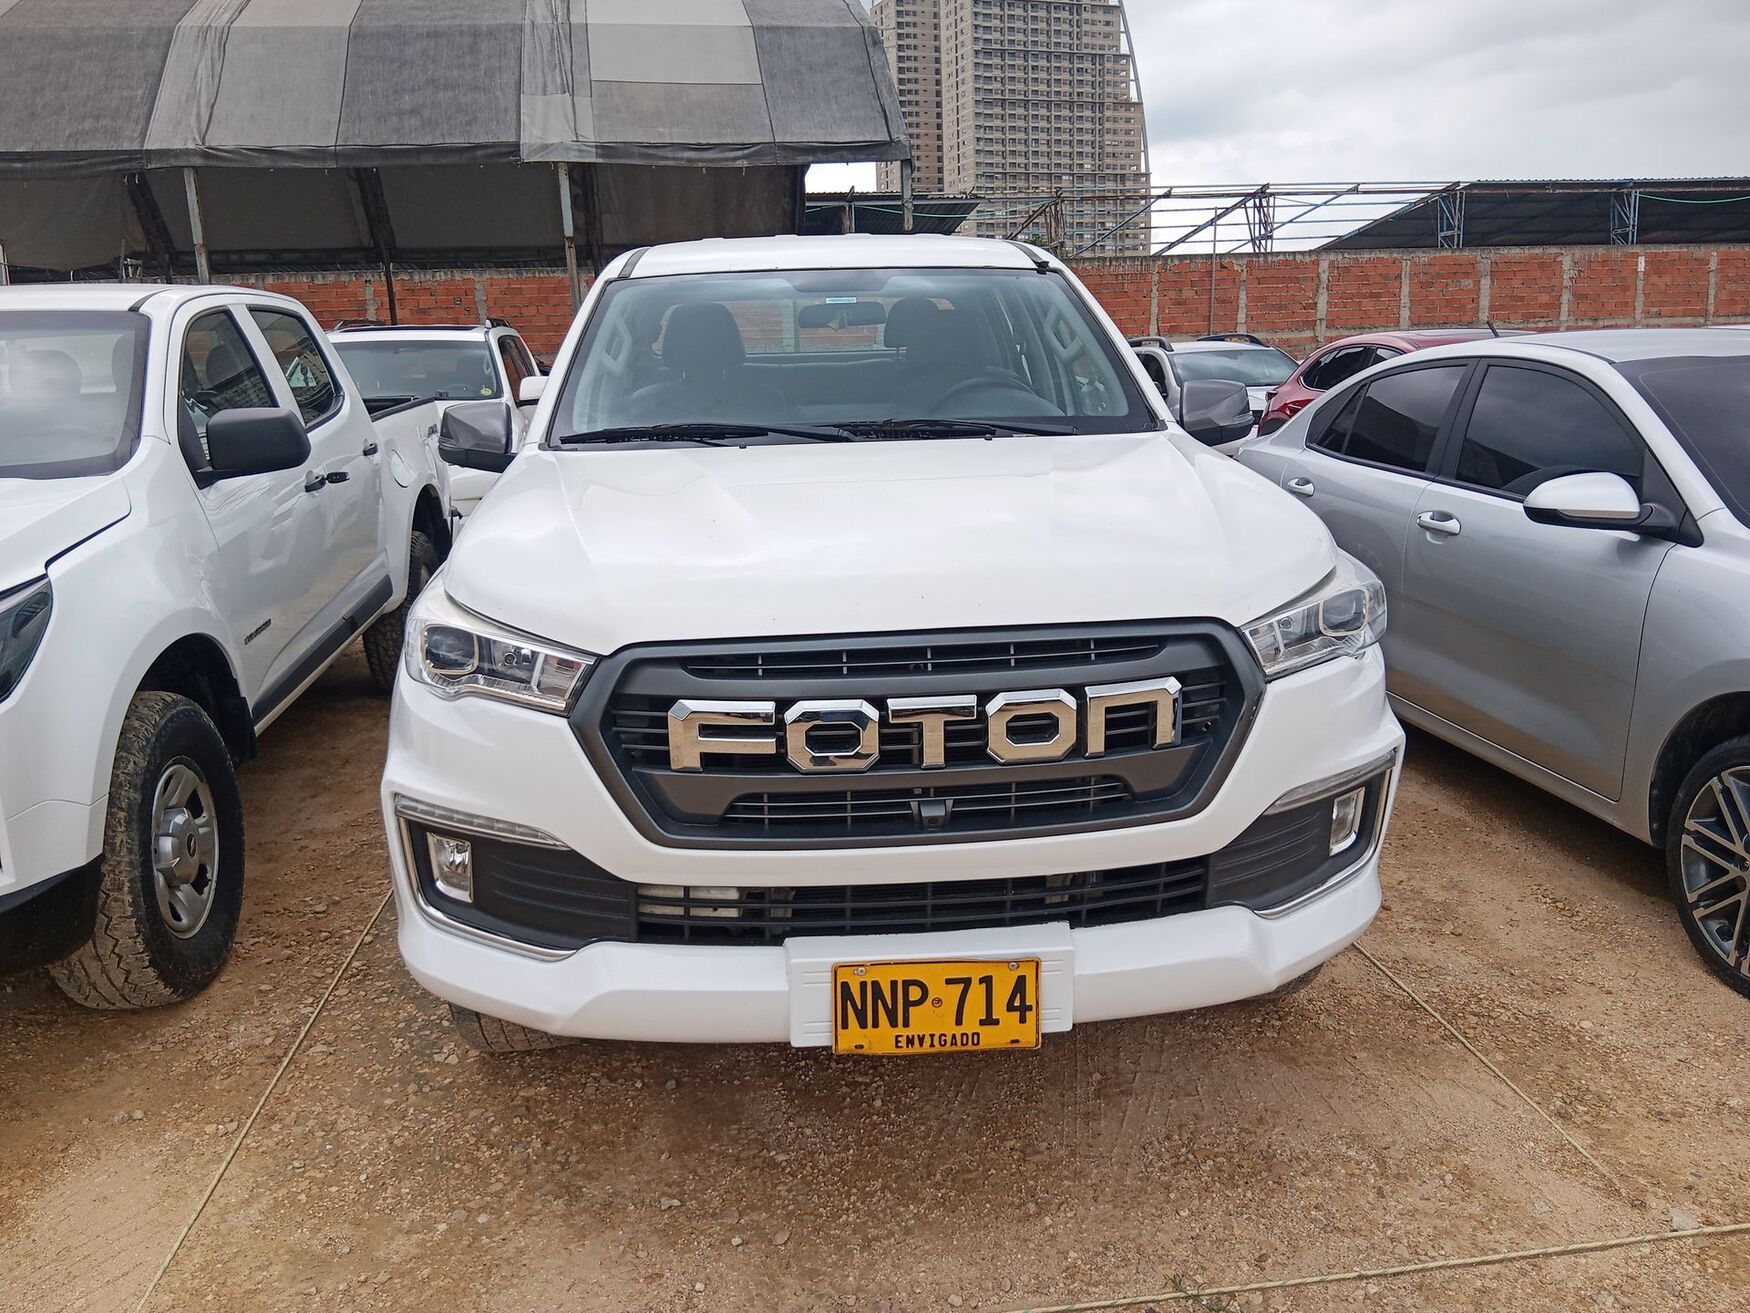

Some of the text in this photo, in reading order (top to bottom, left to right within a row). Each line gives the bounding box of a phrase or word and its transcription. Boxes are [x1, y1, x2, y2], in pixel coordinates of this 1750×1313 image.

[667, 676, 1182, 773] FOTON
[840, 974, 1033, 1030] NNP 714
[894, 1031, 981, 1049] ENVIGADO
